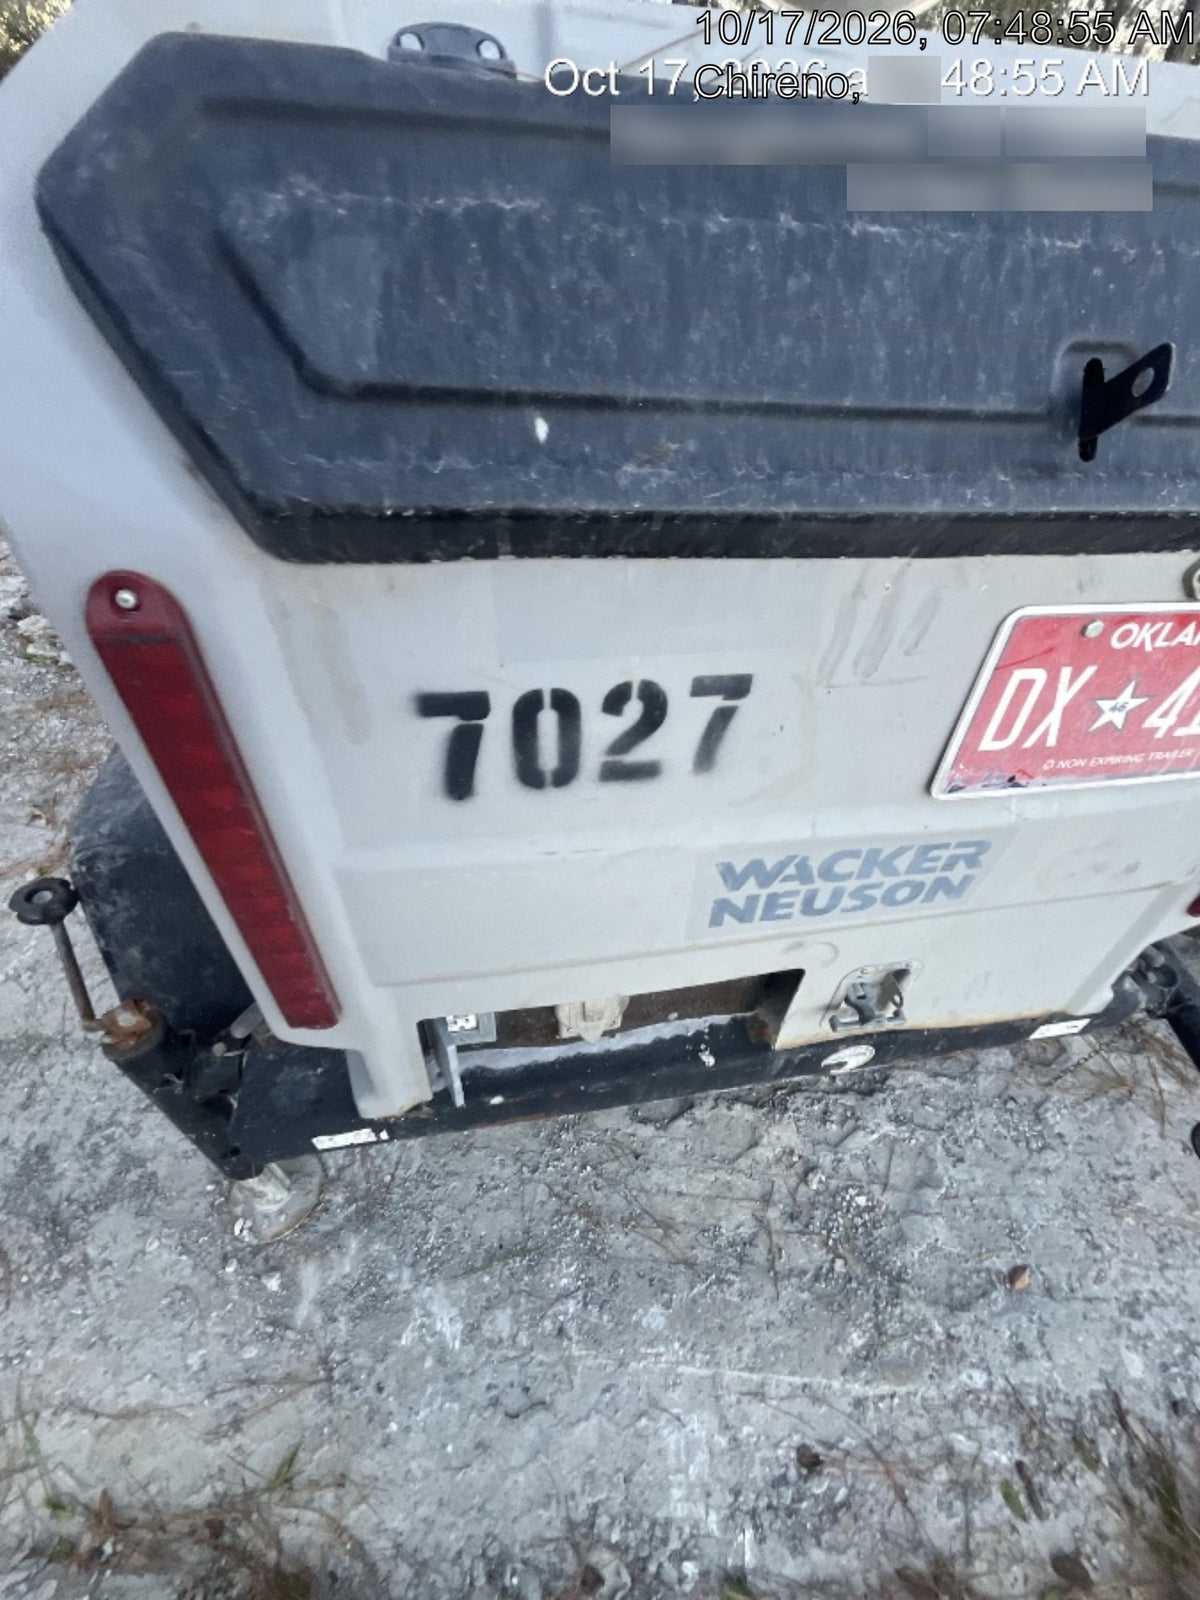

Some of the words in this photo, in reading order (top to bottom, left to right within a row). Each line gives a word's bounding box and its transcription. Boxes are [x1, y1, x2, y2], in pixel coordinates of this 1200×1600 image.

[977, 665, 1099, 751] DX
[414, 673, 755, 801] 7027
[1056, 758, 1088, 769] NON
[1089, 752, 1146, 767] EXPIRING
[1147, 748, 1195, 761] TRAILER
[715, 840, 992, 892] WACKER
[708, 874, 977, 928] NEUSON
